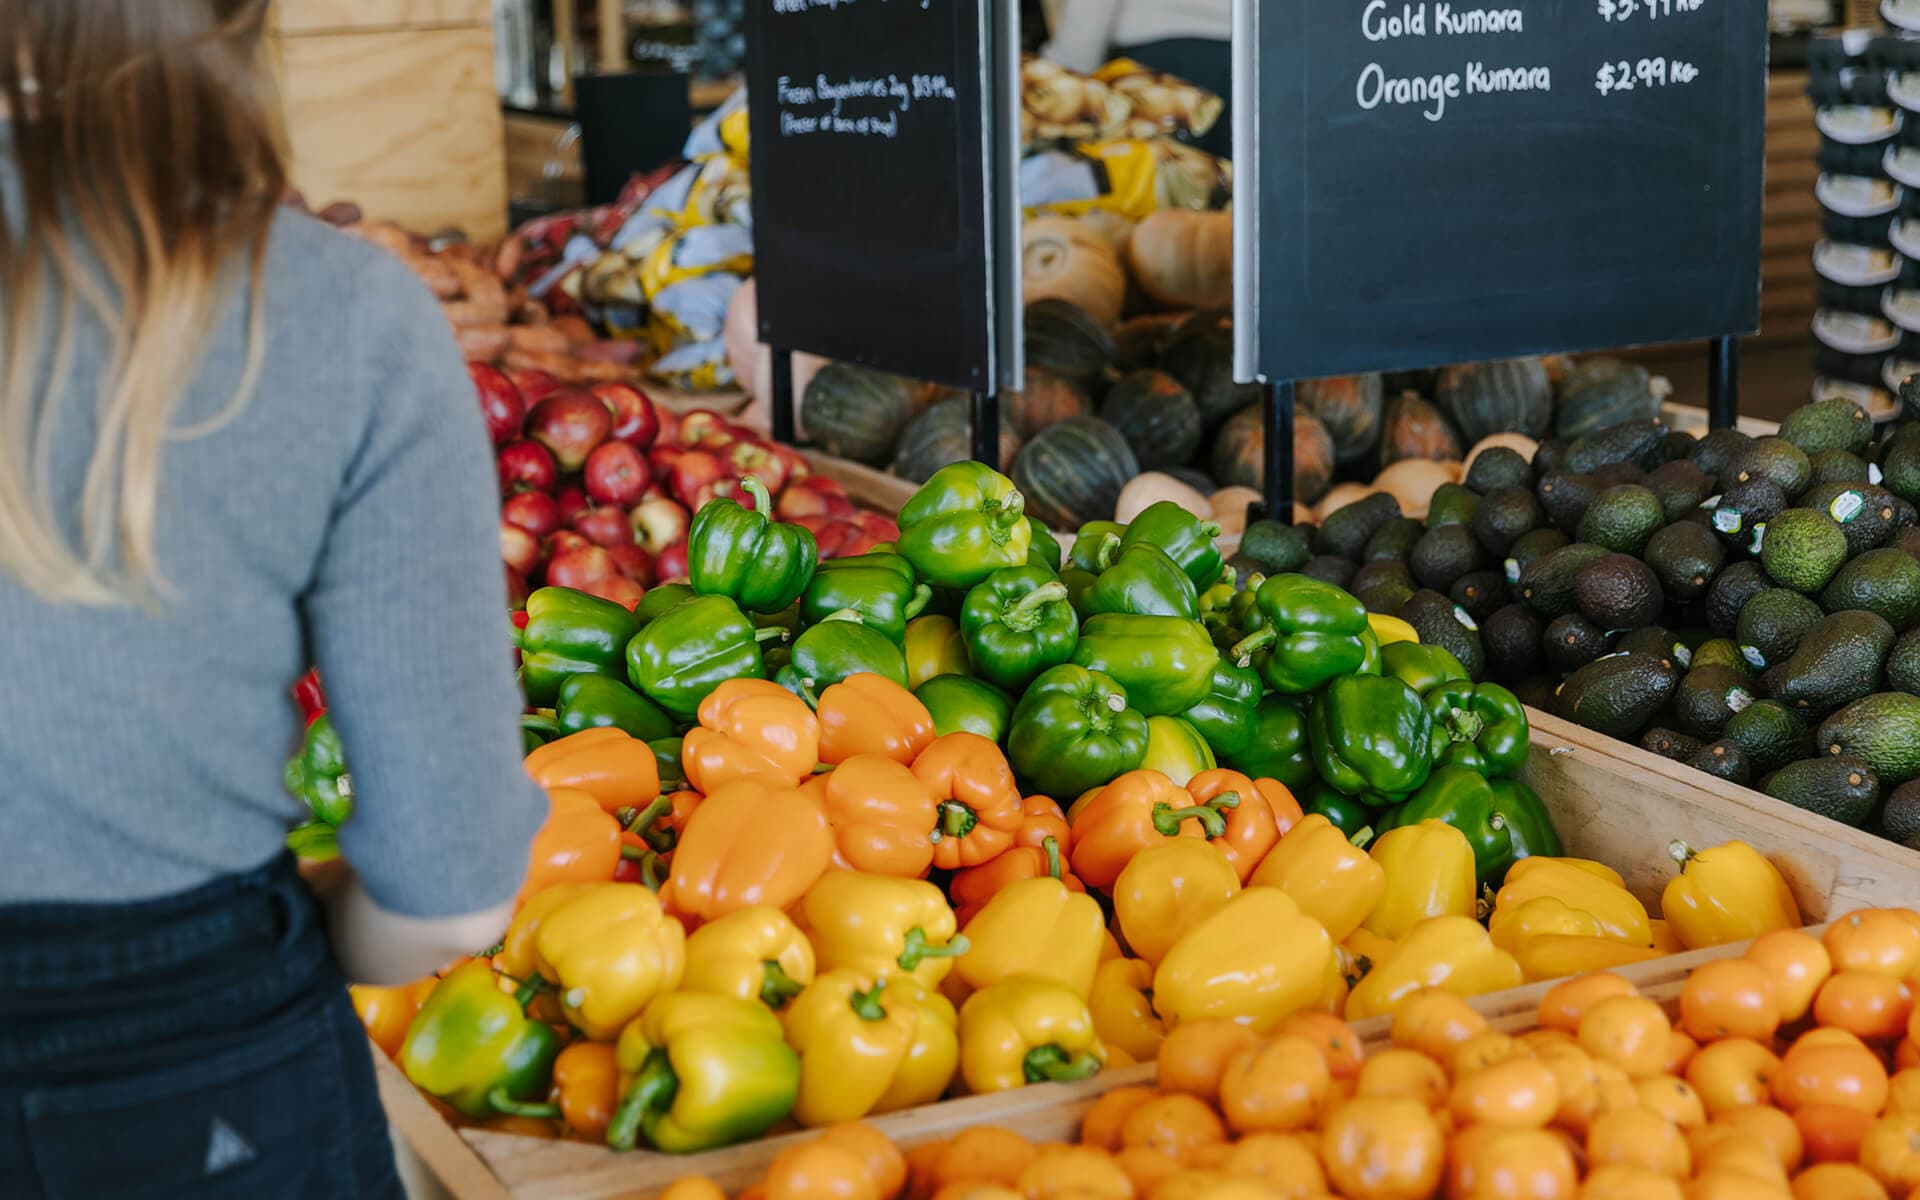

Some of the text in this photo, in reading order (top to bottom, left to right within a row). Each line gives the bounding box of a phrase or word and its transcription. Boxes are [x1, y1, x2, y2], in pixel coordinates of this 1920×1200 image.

[1361, 0, 1426, 41] Gold
[1434, 2, 1523, 37] Kumara
[1356, 62, 1461, 122] Orange
[1465, 61, 1551, 95] Kumara
[1594, 56, 1666, 97] $2.99
